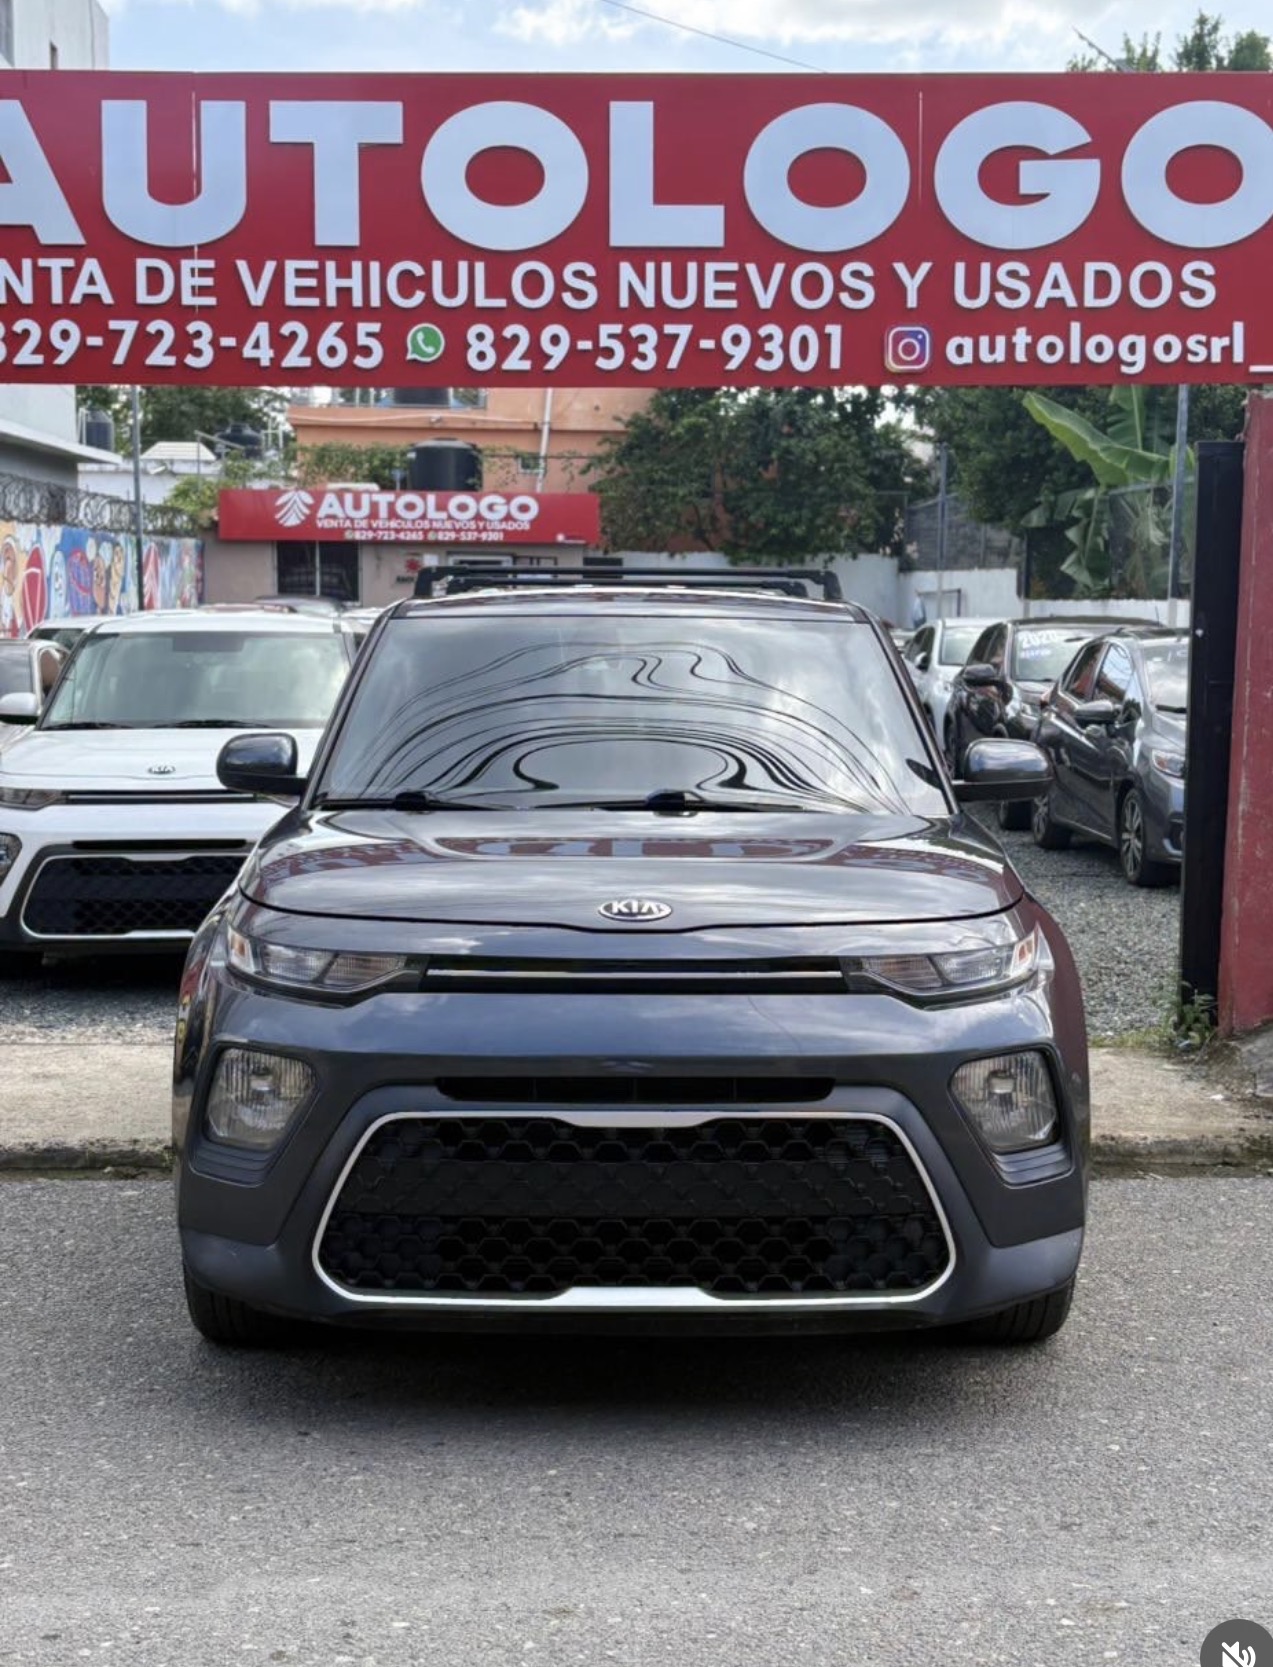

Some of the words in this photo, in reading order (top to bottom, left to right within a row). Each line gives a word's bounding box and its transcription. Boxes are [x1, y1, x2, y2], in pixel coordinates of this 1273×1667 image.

[0, 258, 114, 304] NTA
[136, 258, 217, 306] DE
[237, 260, 598, 309] VEHICULOS
[620, 261, 875, 310] NUEVOS
[893, 261, 933, 308] Y
[955, 261, 1216, 309] USADOS
[0, 319, 383, 368] 29-723-4265
[467, 323, 842, 371] 829-537-9301
[316, 519, 352, 529] VENTA
[354, 518, 369, 529] DE
[432, 519, 476, 531] NUEVOS
[478, 519, 485, 530] Y
[486, 520, 530, 531] USADOS
[317, 493, 539, 520] AUTOLOGO
